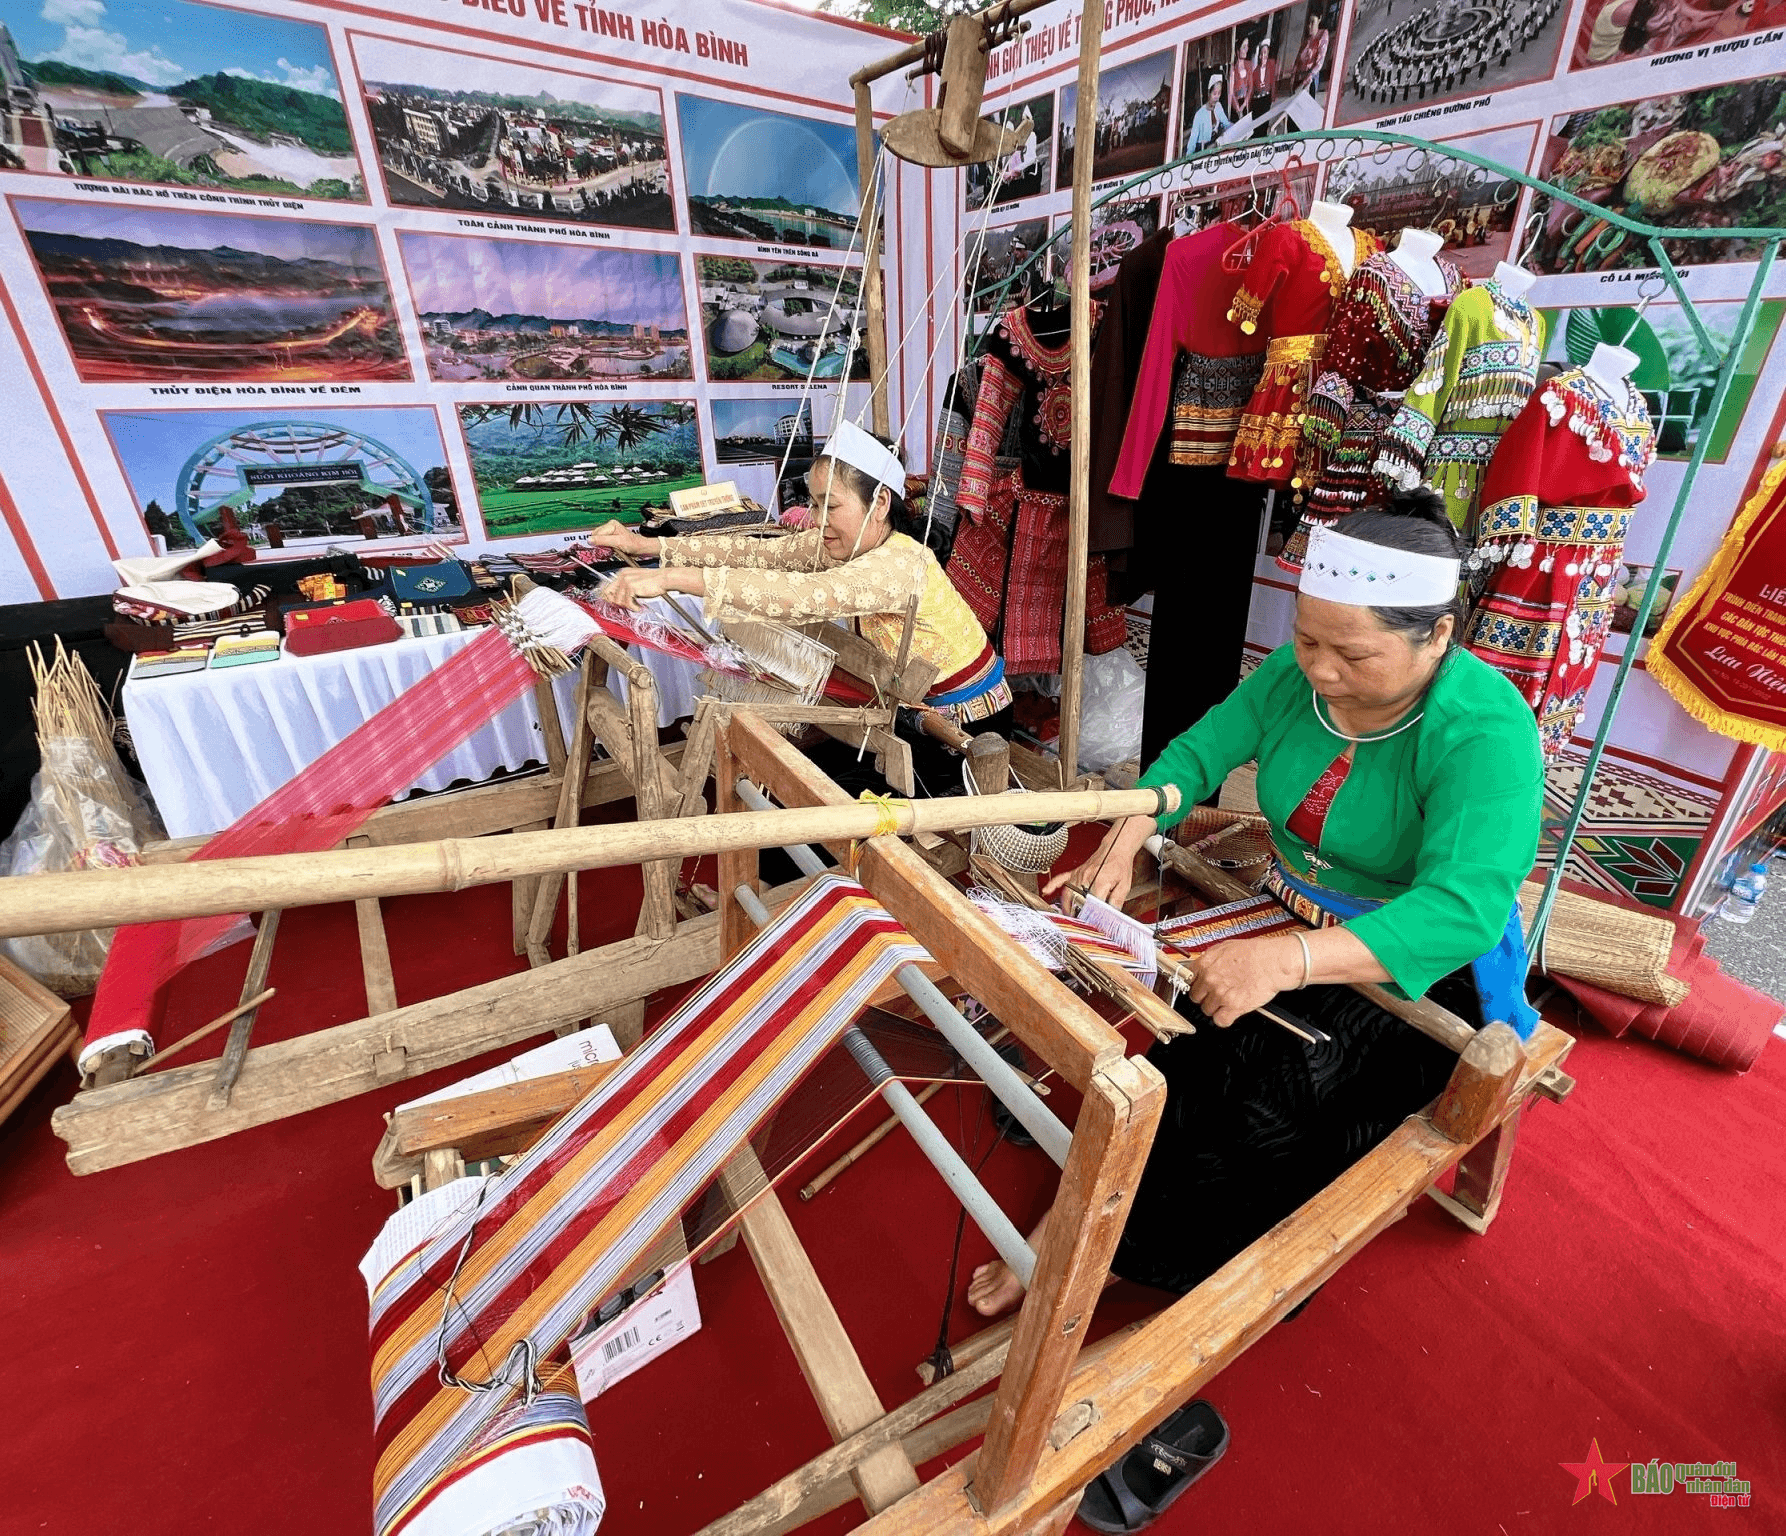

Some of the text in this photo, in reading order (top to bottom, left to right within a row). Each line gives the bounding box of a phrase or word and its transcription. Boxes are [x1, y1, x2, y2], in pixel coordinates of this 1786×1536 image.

[574, 0, 635, 42] TỈNH
[641, 17, 690, 54] HÒA
[695, 30, 749, 67] BÌNH
[986, 52, 1000, 81] NH
[1025, 24, 1056, 65] THIỆU
[1058, 9, 1072, 52] VỀ
[1650, 51, 1694, 67] HƯƠNG
[1697, 48, 1710, 58] VỊ
[1712, 39, 1750, 54] RƯỢU
[1413, 108, 1442, 120] CHIÊNG
[1444, 102, 1471, 114] ĐƯỜNG
[1473, 95, 1492, 108] PHỐ
[171, 191, 198, 200] TRÊN
[200, 194, 226, 203] CÔNG
[228, 196, 256, 206] TRÌNH
[457, 219, 610, 239] TOÀN CẢNH THÀNH PHỐ HÒA BÌNH
[150, 384, 190, 395] THỦY
[195, 386, 232, 396] ĐIỆN
[236, 386, 267, 394] HÒA
[270, 386, 306, 394] BÌNH
[330, 386, 362, 394] ĐÊM
[506, 383, 528, 392] CẢNH
[530, 384, 550, 392] QUAN
[578, 383, 593, 391] PHỐ
[1703, 622, 1720, 633] KHU
[1720, 611, 1739, 624] CÁC
[1736, 618, 1756, 632] DÂN
[1754, 624, 1771, 638] TỘC
[1704, 646, 1742, 669] Lưu
